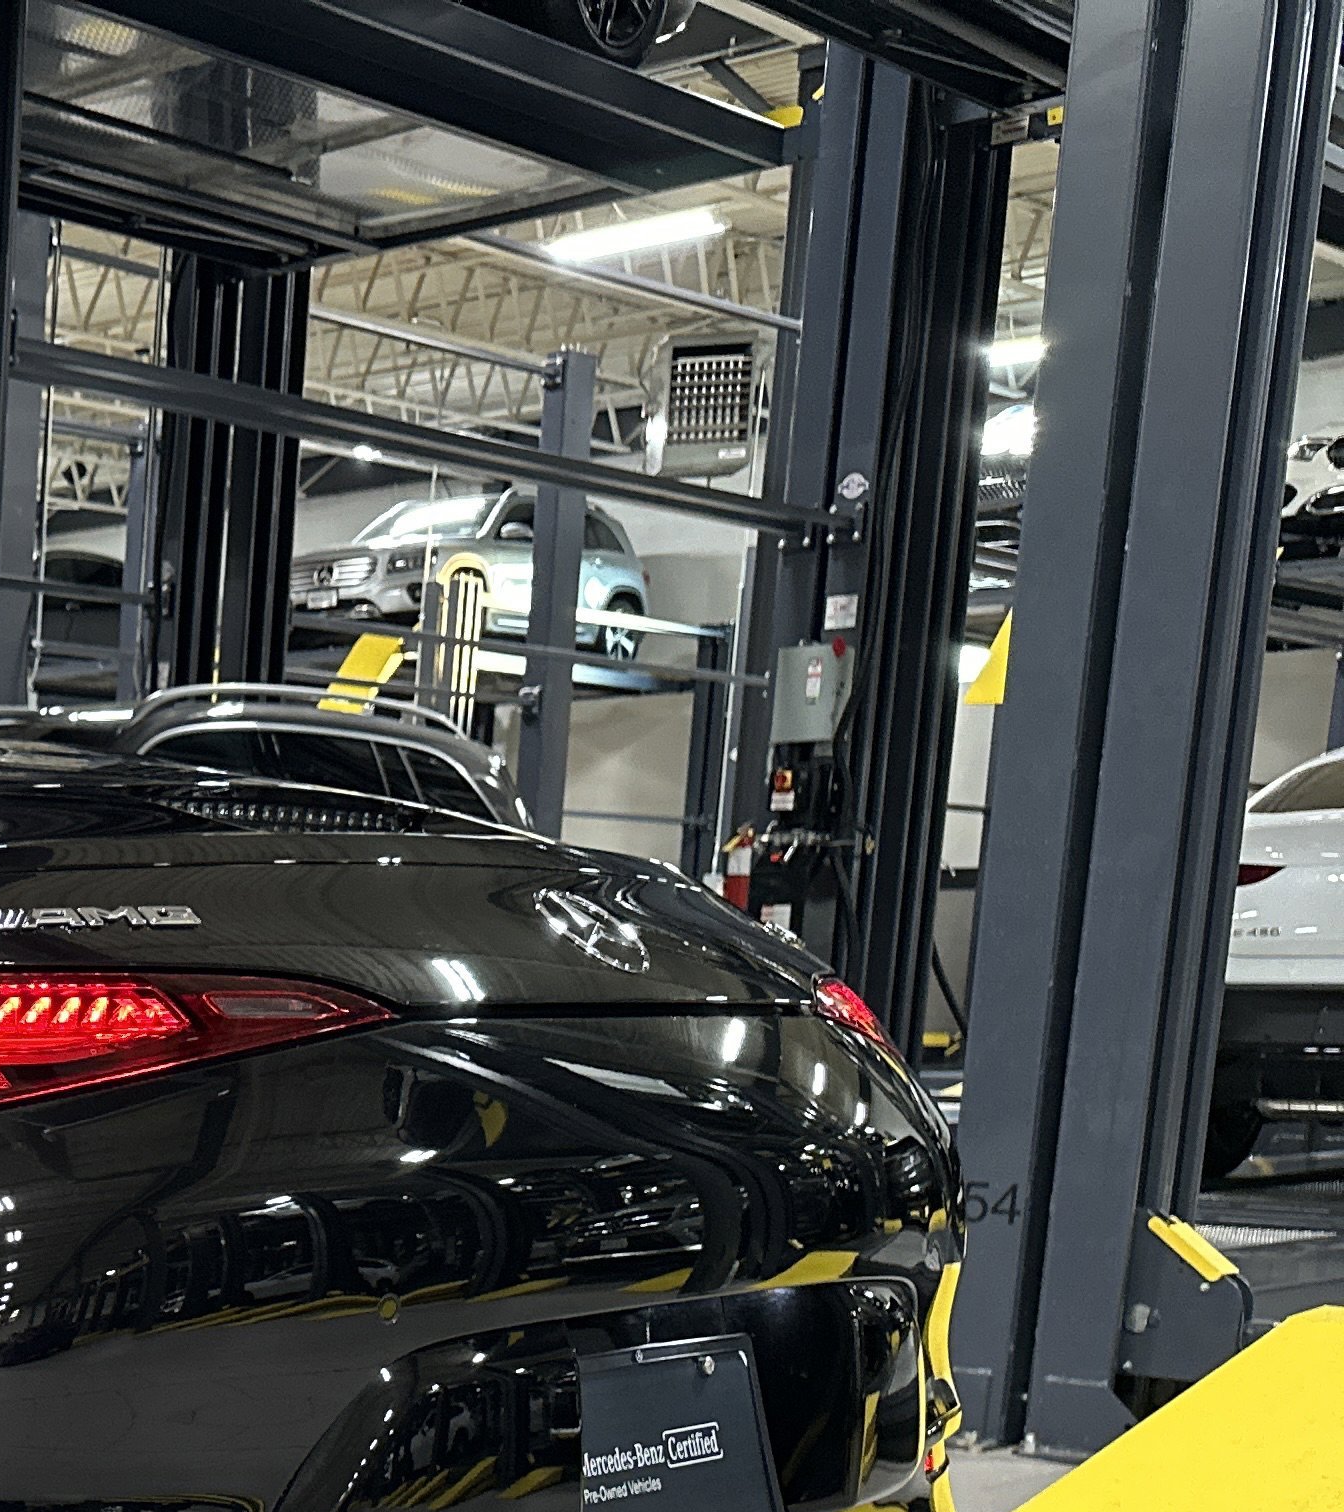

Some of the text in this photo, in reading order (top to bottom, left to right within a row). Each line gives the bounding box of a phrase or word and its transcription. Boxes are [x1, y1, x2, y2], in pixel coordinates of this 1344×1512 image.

[23, 905, 203, 933] AMG
[965, 1181, 1021, 1226] 54
[667, 1430, 720, 1461] Certified
[583, 1476, 662, 1505] Pre-Owned Vehicles
